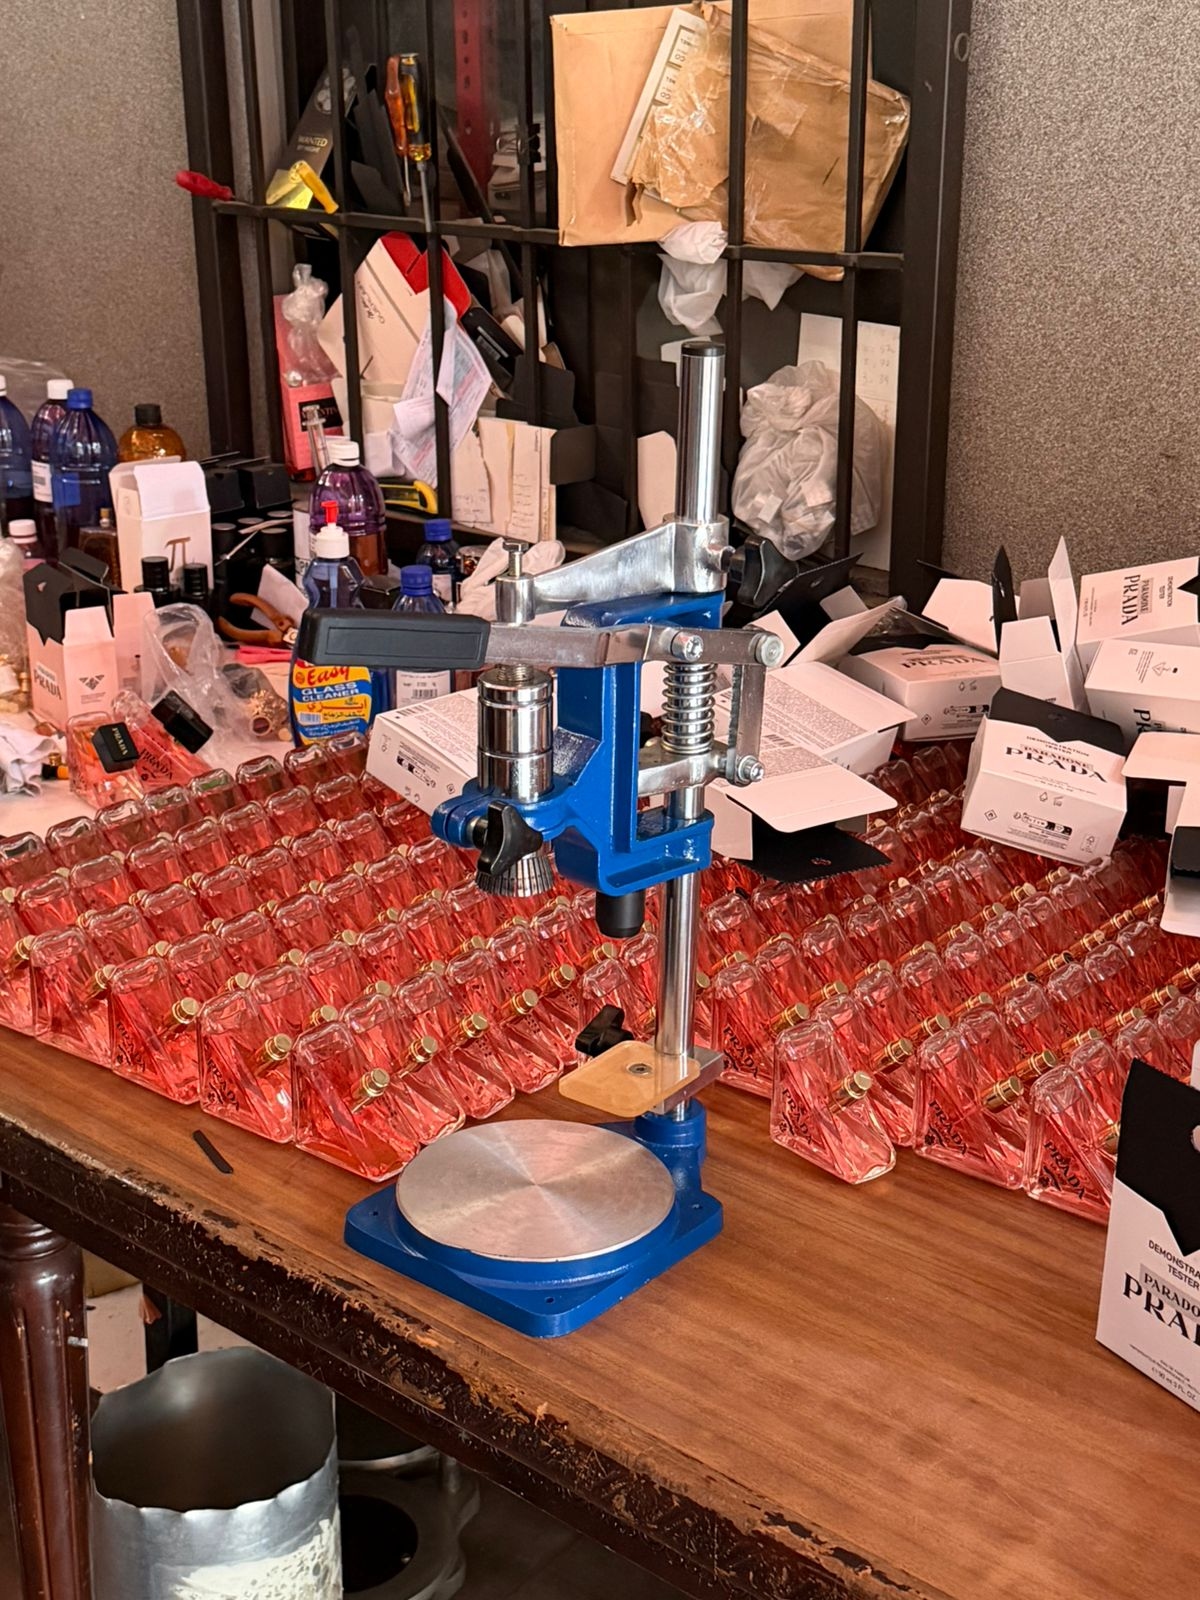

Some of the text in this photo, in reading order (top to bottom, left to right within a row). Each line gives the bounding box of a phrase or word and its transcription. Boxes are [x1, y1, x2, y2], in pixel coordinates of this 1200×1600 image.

[1121, 574, 1141, 626] PRADA
[301, 682, 357, 696] GLASS
[307, 666, 350, 686] Easy
[302, 689, 359, 702] CLEANER
[112, 727, 129, 756] PRADA
[140, 748, 173, 780] PRADA
[1005, 746, 1108, 783] PRADA
[723, 1026, 758, 1078] PRADA
[782, 1088, 812, 1145] PRADA
[929, 1100, 967, 1155] PRADA
[1044, 1141, 1086, 1200] PRADA
[1167, 1263, 1200, 1292] TESTER
